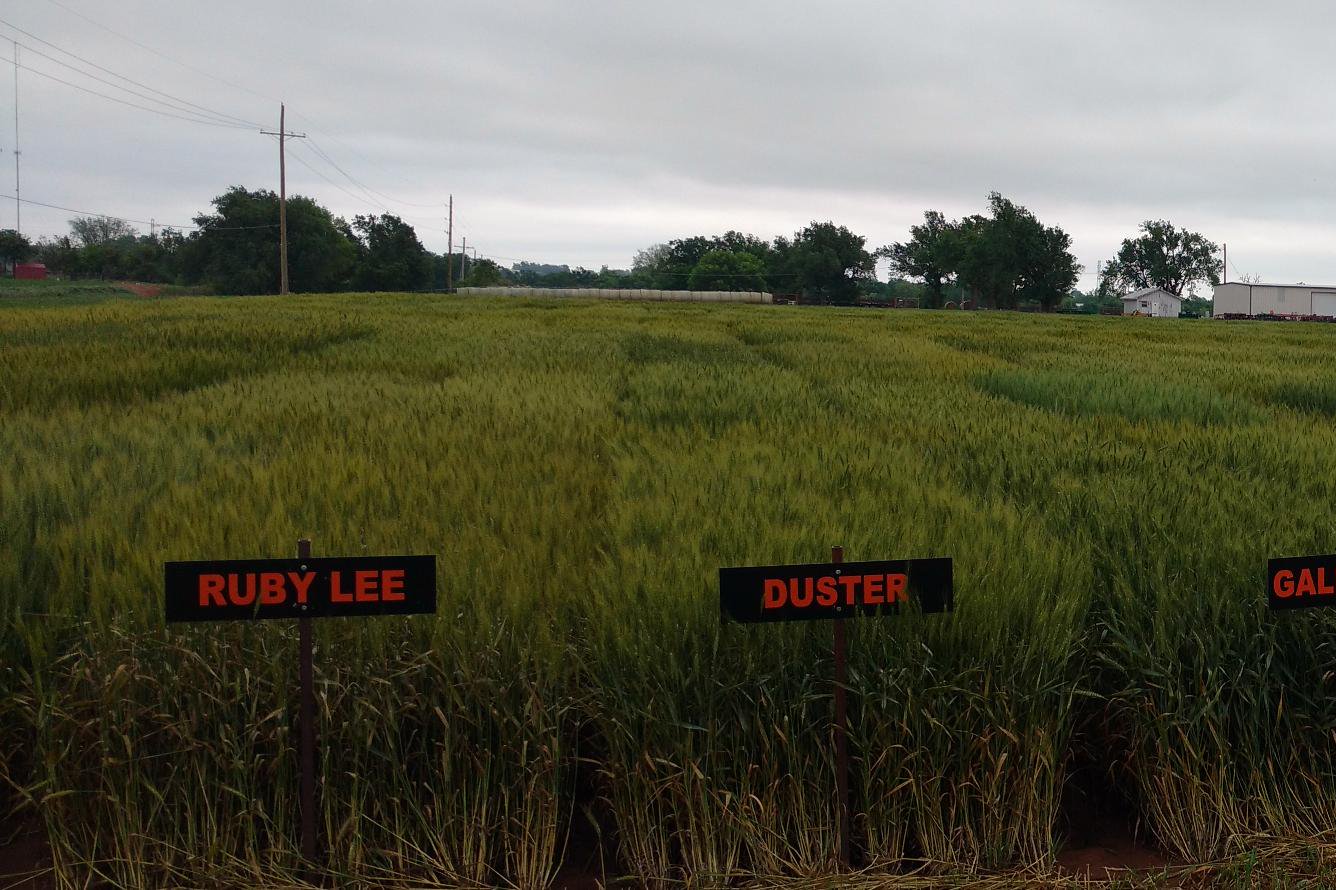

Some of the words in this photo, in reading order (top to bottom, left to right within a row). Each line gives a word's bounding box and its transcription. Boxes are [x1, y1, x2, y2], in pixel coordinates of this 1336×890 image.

[199, 571, 317, 606] RUBY
[331, 569, 405, 602] LEE
[764, 573, 908, 609] DUSTER
